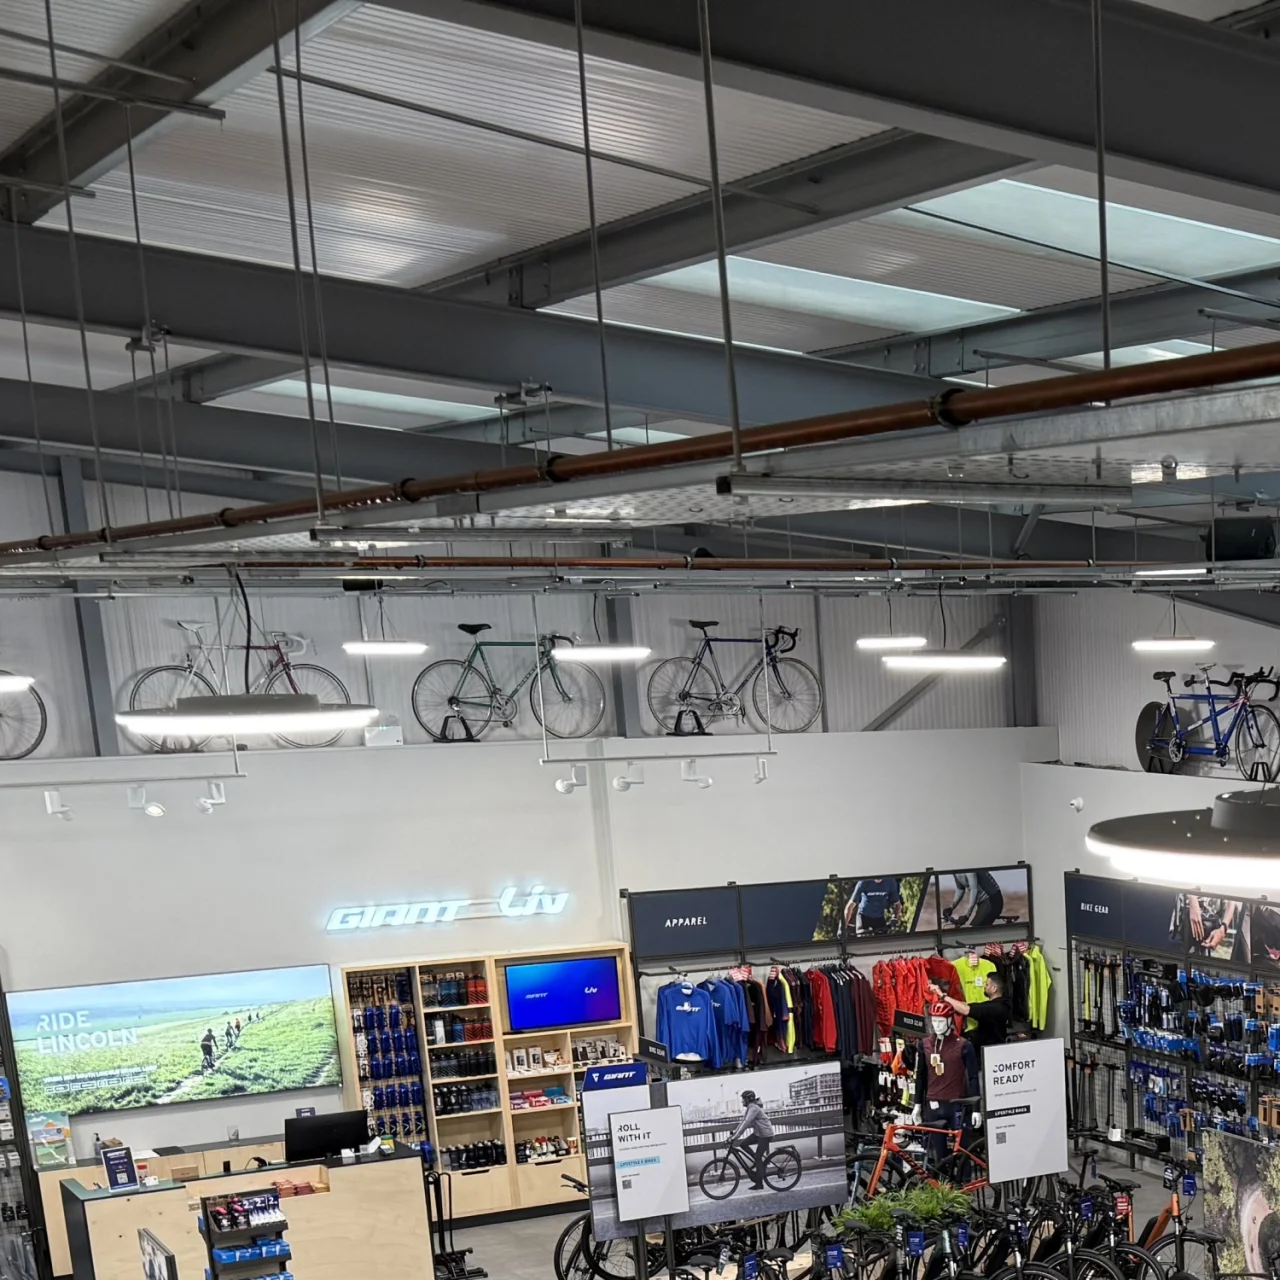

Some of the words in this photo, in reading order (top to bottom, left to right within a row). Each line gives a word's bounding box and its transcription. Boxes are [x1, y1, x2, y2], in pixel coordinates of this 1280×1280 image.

[326, 899, 472, 932] GIANT
[498, 885, 569, 917] Liv
[1081, 902, 1093, 912] BIKE
[1094, 904, 1109, 914] GEAR
[665, 916, 708, 928] APPAREL
[37, 1010, 91, 1033] RIDE
[37, 1028, 139, 1054] LINCOLN
[993, 1060, 1036, 1073] COMFORT
[603, 1071, 636, 1080] GIANT
[993, 1074, 1024, 1085] READY
[617, 1122, 641, 1133] ROLL
[618, 1133, 641, 1143] WITH
[643, 1131, 651, 1140] IT
